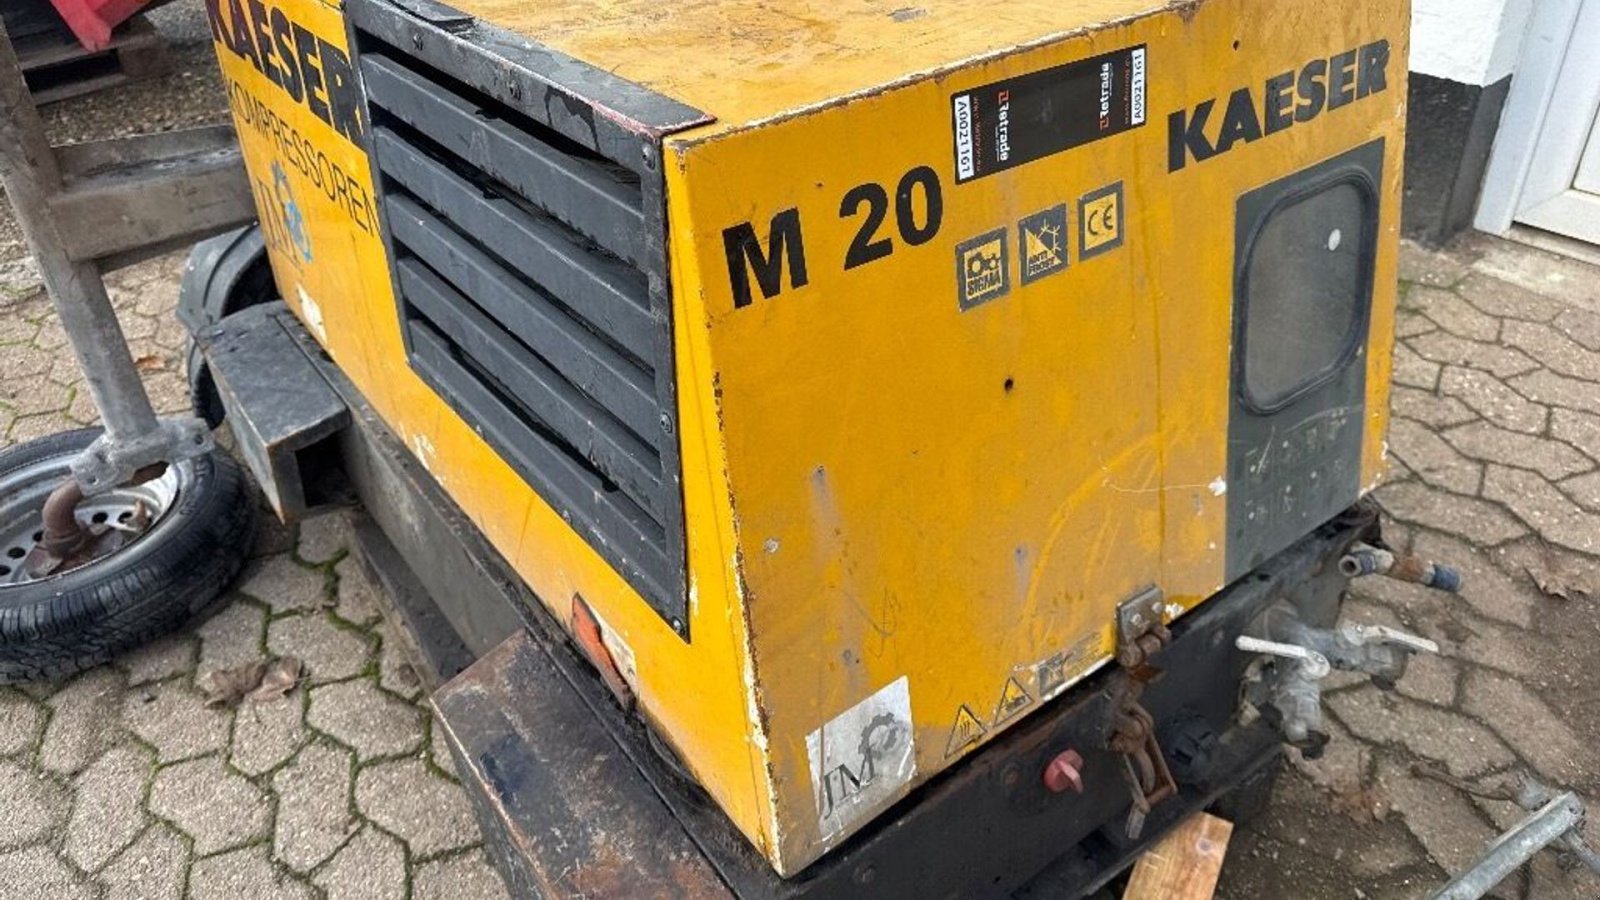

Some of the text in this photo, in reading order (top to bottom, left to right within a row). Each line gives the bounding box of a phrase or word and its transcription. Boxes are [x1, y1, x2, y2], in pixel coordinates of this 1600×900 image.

[1168, 39, 1390, 174] KAESER
[722, 166, 943, 310] M 20
[967, 269, 1001, 297] SIGMA
